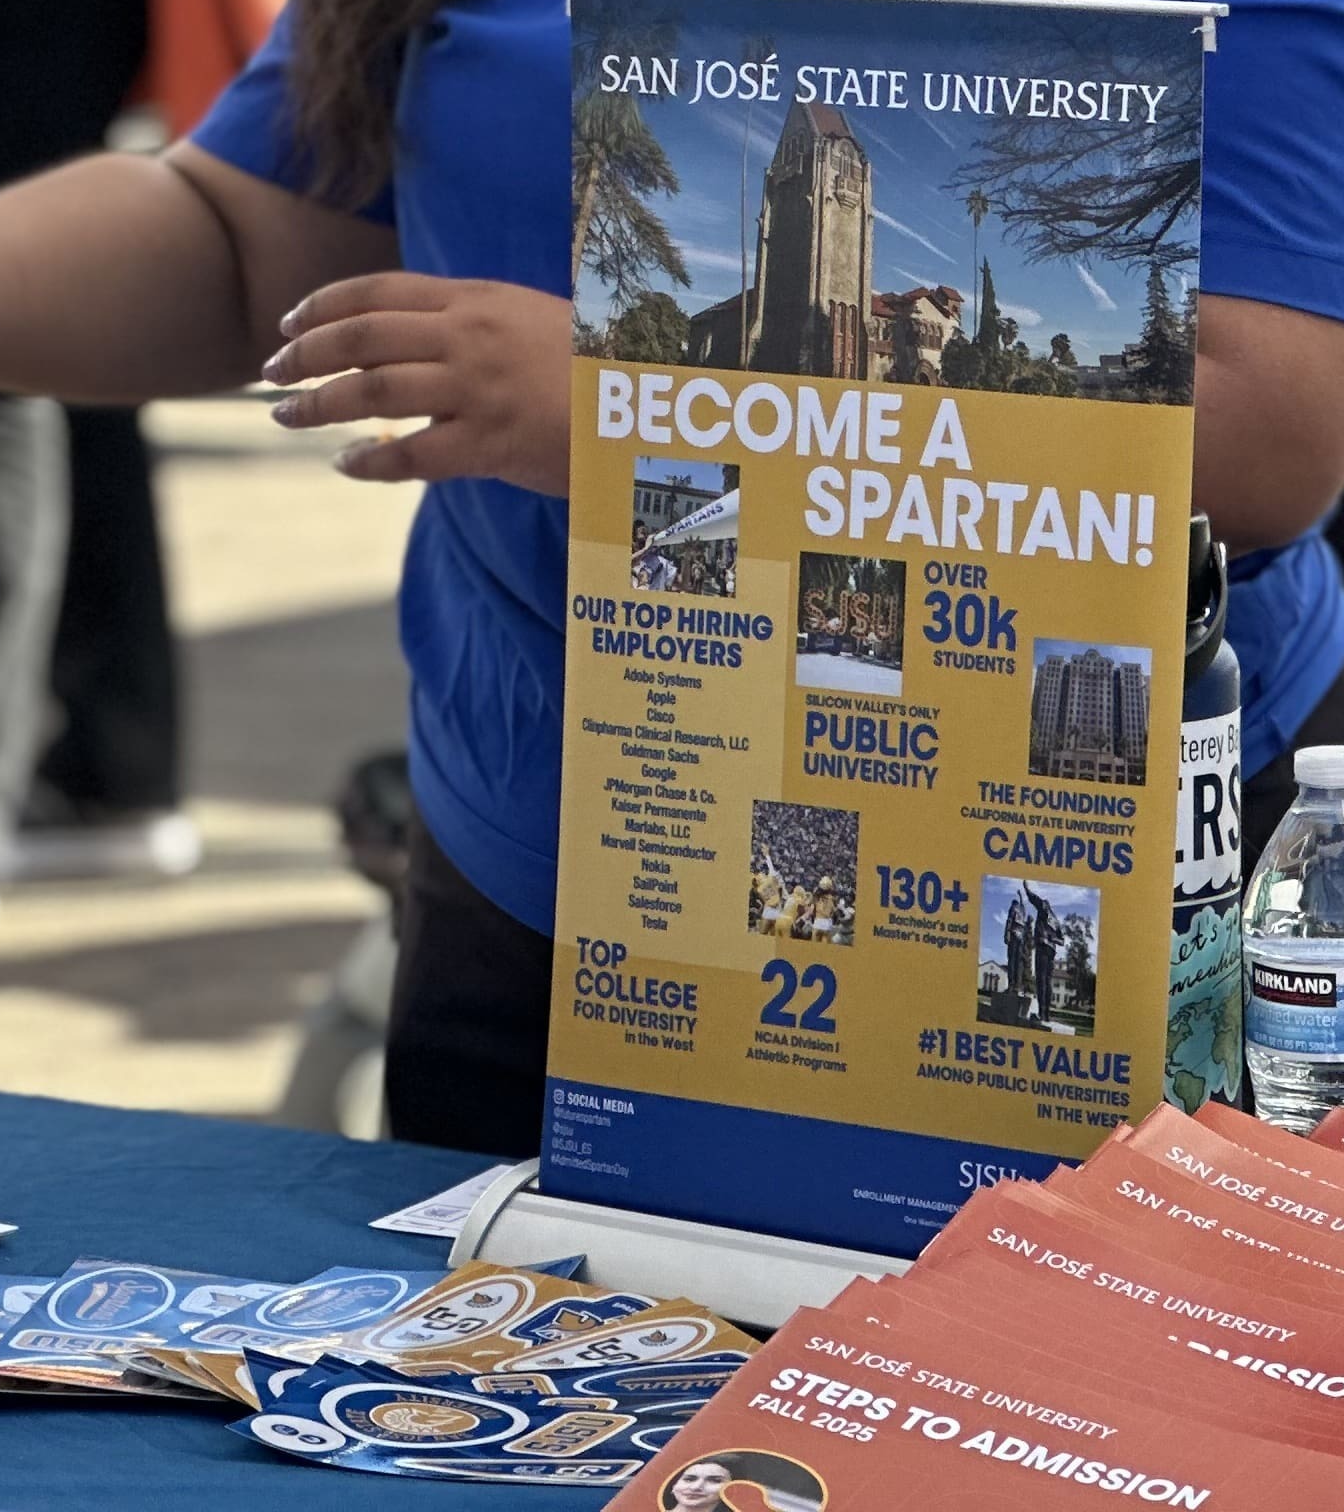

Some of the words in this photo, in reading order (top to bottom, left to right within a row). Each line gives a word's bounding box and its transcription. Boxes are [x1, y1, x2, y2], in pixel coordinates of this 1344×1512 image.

[601, 55, 678, 95] SAN
[688, 54, 780, 104] JOSÉ
[795, 66, 908, 108] STATE
[923, 74, 1168, 123] UNIVERSITY
[598, 370, 901, 464] BECOME
[920, 398, 972, 471] A
[805, 465, 1155, 568] SPARTAN!
[924, 560, 987, 589] OVER
[573, 595, 616, 624] OUR
[622, 601, 672, 629] TOP
[677, 607, 773, 641] HIRING
[922, 590, 1018, 651] 30k
[592, 628, 742, 668] EMPLOYERS
[933, 650, 1016, 675] STUDENTS
[624, 667, 655, 685] Adobe
[657, 671, 702, 689] Systems
[647, 689, 676, 706] Apple
[805, 693, 853, 711] SILICON
[854, 698, 906, 717] VALLEY'S
[909, 705, 941, 720] ONLY
[647, 708, 675, 724] Cisco
[635, 725, 672, 743] Clinical
[674, 730, 726, 750] Research,
[729, 736, 750, 751] LLC
[805, 710, 939, 761] PUBLIC
[1181, 731, 1224, 763] terey
[621, 742, 665, 761] Goldman
[667, 748, 699, 764] Sachs
[641, 764, 677, 782] Google
[804, 751, 938, 790] UNIVERSITY
[603, 777, 652, 797] JPMorgan
[656, 785, 687, 802] Chase
[689, 788, 698, 802] &
[700, 790, 717, 804] Co.
[978, 781, 1015, 805] THE
[1019, 787, 1136, 818] FOUNDING
[611, 797, 642, 815] Kaiser
[644, 802, 707, 824] Permanente
[960, 806, 1026, 826] CALIFORNIA
[1028, 814, 1063, 830] STATE
[1065, 818, 1135, 838] UNIVERSITY
[1176, 763, 1240, 864] RS
[671, 824, 691, 838] LLC
[601, 834, 636, 850] Marvell
[638, 839, 717, 862] Semiconductor
[983, 827, 1134, 875] CAMPUS
[641, 858, 670, 875] Nokia
[628, 894, 682, 914] Salesforce
[876, 864, 969, 914] 130+
[641, 915, 668, 931] Tesla
[873, 925, 920, 944] Master's
[922, 932, 968, 949] degrees
[888, 913, 946, 932] Bachelor's
[947, 920, 968, 934] and
[576, 936, 627, 969] TOP
[1170, 915, 1217, 965] et's
[575, 968, 698, 1011] COLLEGE
[760, 958, 838, 1034] 22
[1255, 971, 1333, 995] KIRKLAND
[574, 999, 605, 1021] FOR
[609, 1004, 697, 1035] DIVERSITY
[1294, 1012, 1337, 1027] water
[625, 1031, 636, 1044] in
[638, 1032, 659, 1047] the
[662, 1036, 694, 1052] West
[755, 1030, 788, 1046] NCAA
[791, 1035, 834, 1053] Division
[918, 1028, 947, 1058] #1
[954, 1031, 1024, 1069] BEST
[1031, 1042, 1131, 1085] VALUE
[745, 1047, 790, 1065] Athletic
[792, 1052, 847, 1073] Programs
[916, 1063, 974, 1085] AMONG
[976, 1072, 1027, 1093] PUBLIC
[1031, 1079, 1129, 1107] UNIVERSITIES
[567, 1091, 601, 1110] SOCIAL
[602, 1097, 635, 1115] MEDIA
[1037, 1102, 1052, 1119] IN
[1055, 1106, 1082, 1124] THE
[853, 1188, 906, 1206] ENROLLMENT
[1116, 1179, 1165, 1211] SAN
[1165, 1145, 1206, 1179] SAN
[1210, 1172, 1268, 1202] JOSÉ
[1265, 1194, 1330, 1226] STATE
[987, 1226, 1038, 1259] SAN
[1035, 1248, 1093, 1281] JOSÉ
[1092, 1271, 1160, 1306] STATE
[1162, 1295, 1298, 1345] UNIVERSITY
[804, 1335, 856, 1367] SAN
[854, 1351, 910, 1379] JOSÉ
[910, 1371, 980, 1401] STATE
[982, 1390, 1118, 1441] UNIVERSITY
[748, 1391, 814, 1427] FALL
[809, 1411, 878, 1443] 2025
[769, 1367, 897, 1421] STEPS
[901, 1406, 961, 1442] TO
[960, 1430, 1212, 1510] ADMISSION
